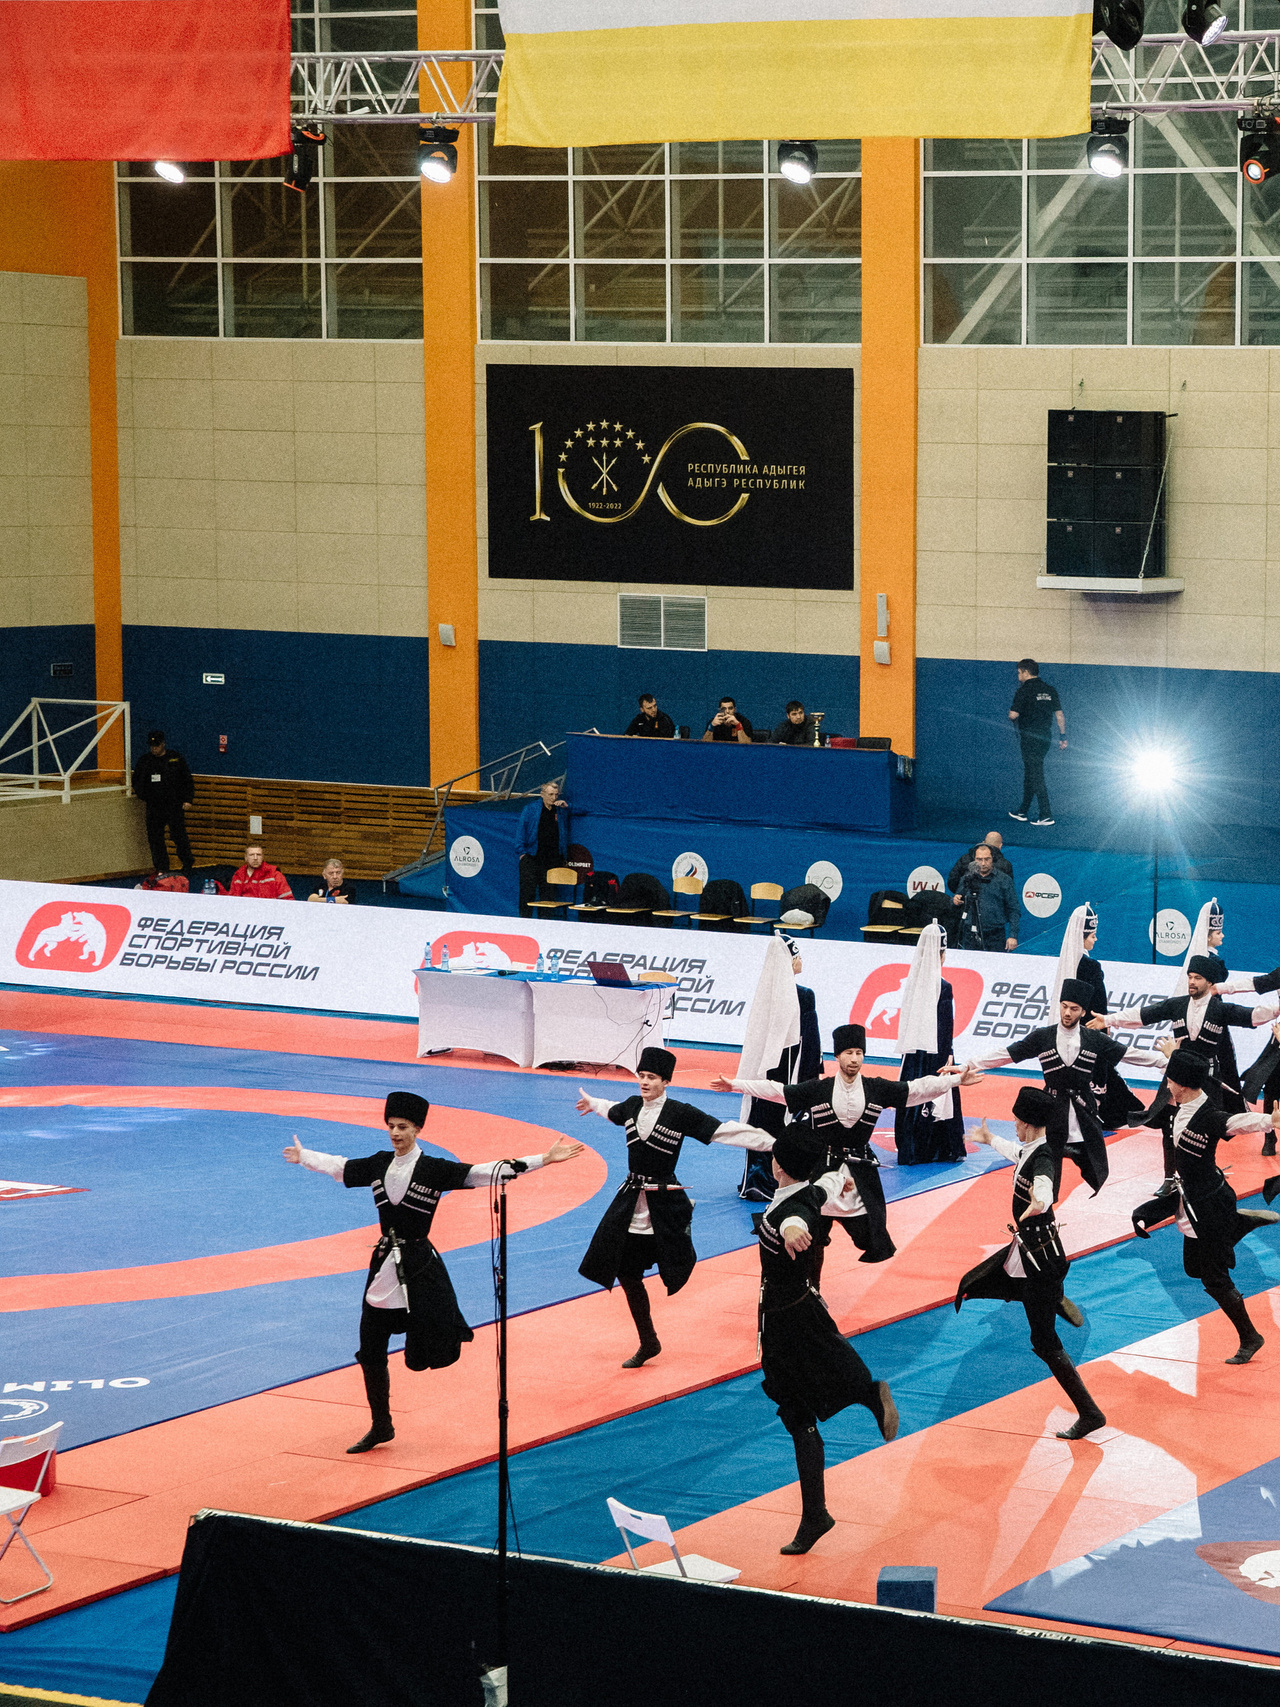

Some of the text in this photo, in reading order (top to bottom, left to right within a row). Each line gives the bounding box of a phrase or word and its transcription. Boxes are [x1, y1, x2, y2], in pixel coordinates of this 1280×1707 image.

[687, 463, 806, 476] РЕСПУБЛИКА АДЫГЕЯ
[687, 477, 806, 489] АДЫГЭ РЕСПУБЛИК
[137, 916, 285, 941] ФЕДЕРАЦИЯ
[1156, 931, 1187, 939] ALROSA
[128, 934, 292, 960] СПОРТИВНОЙ
[119, 952, 320, 981] БОРЬБЫ РОССИИ
[546, 948, 707, 974] ФЕДЕРАЦИЯ
[665, 996, 747, 1016] ССИИ
[973, 1021, 1037, 1039] БОР
[3, 1377, 150, 1393] OLIM
